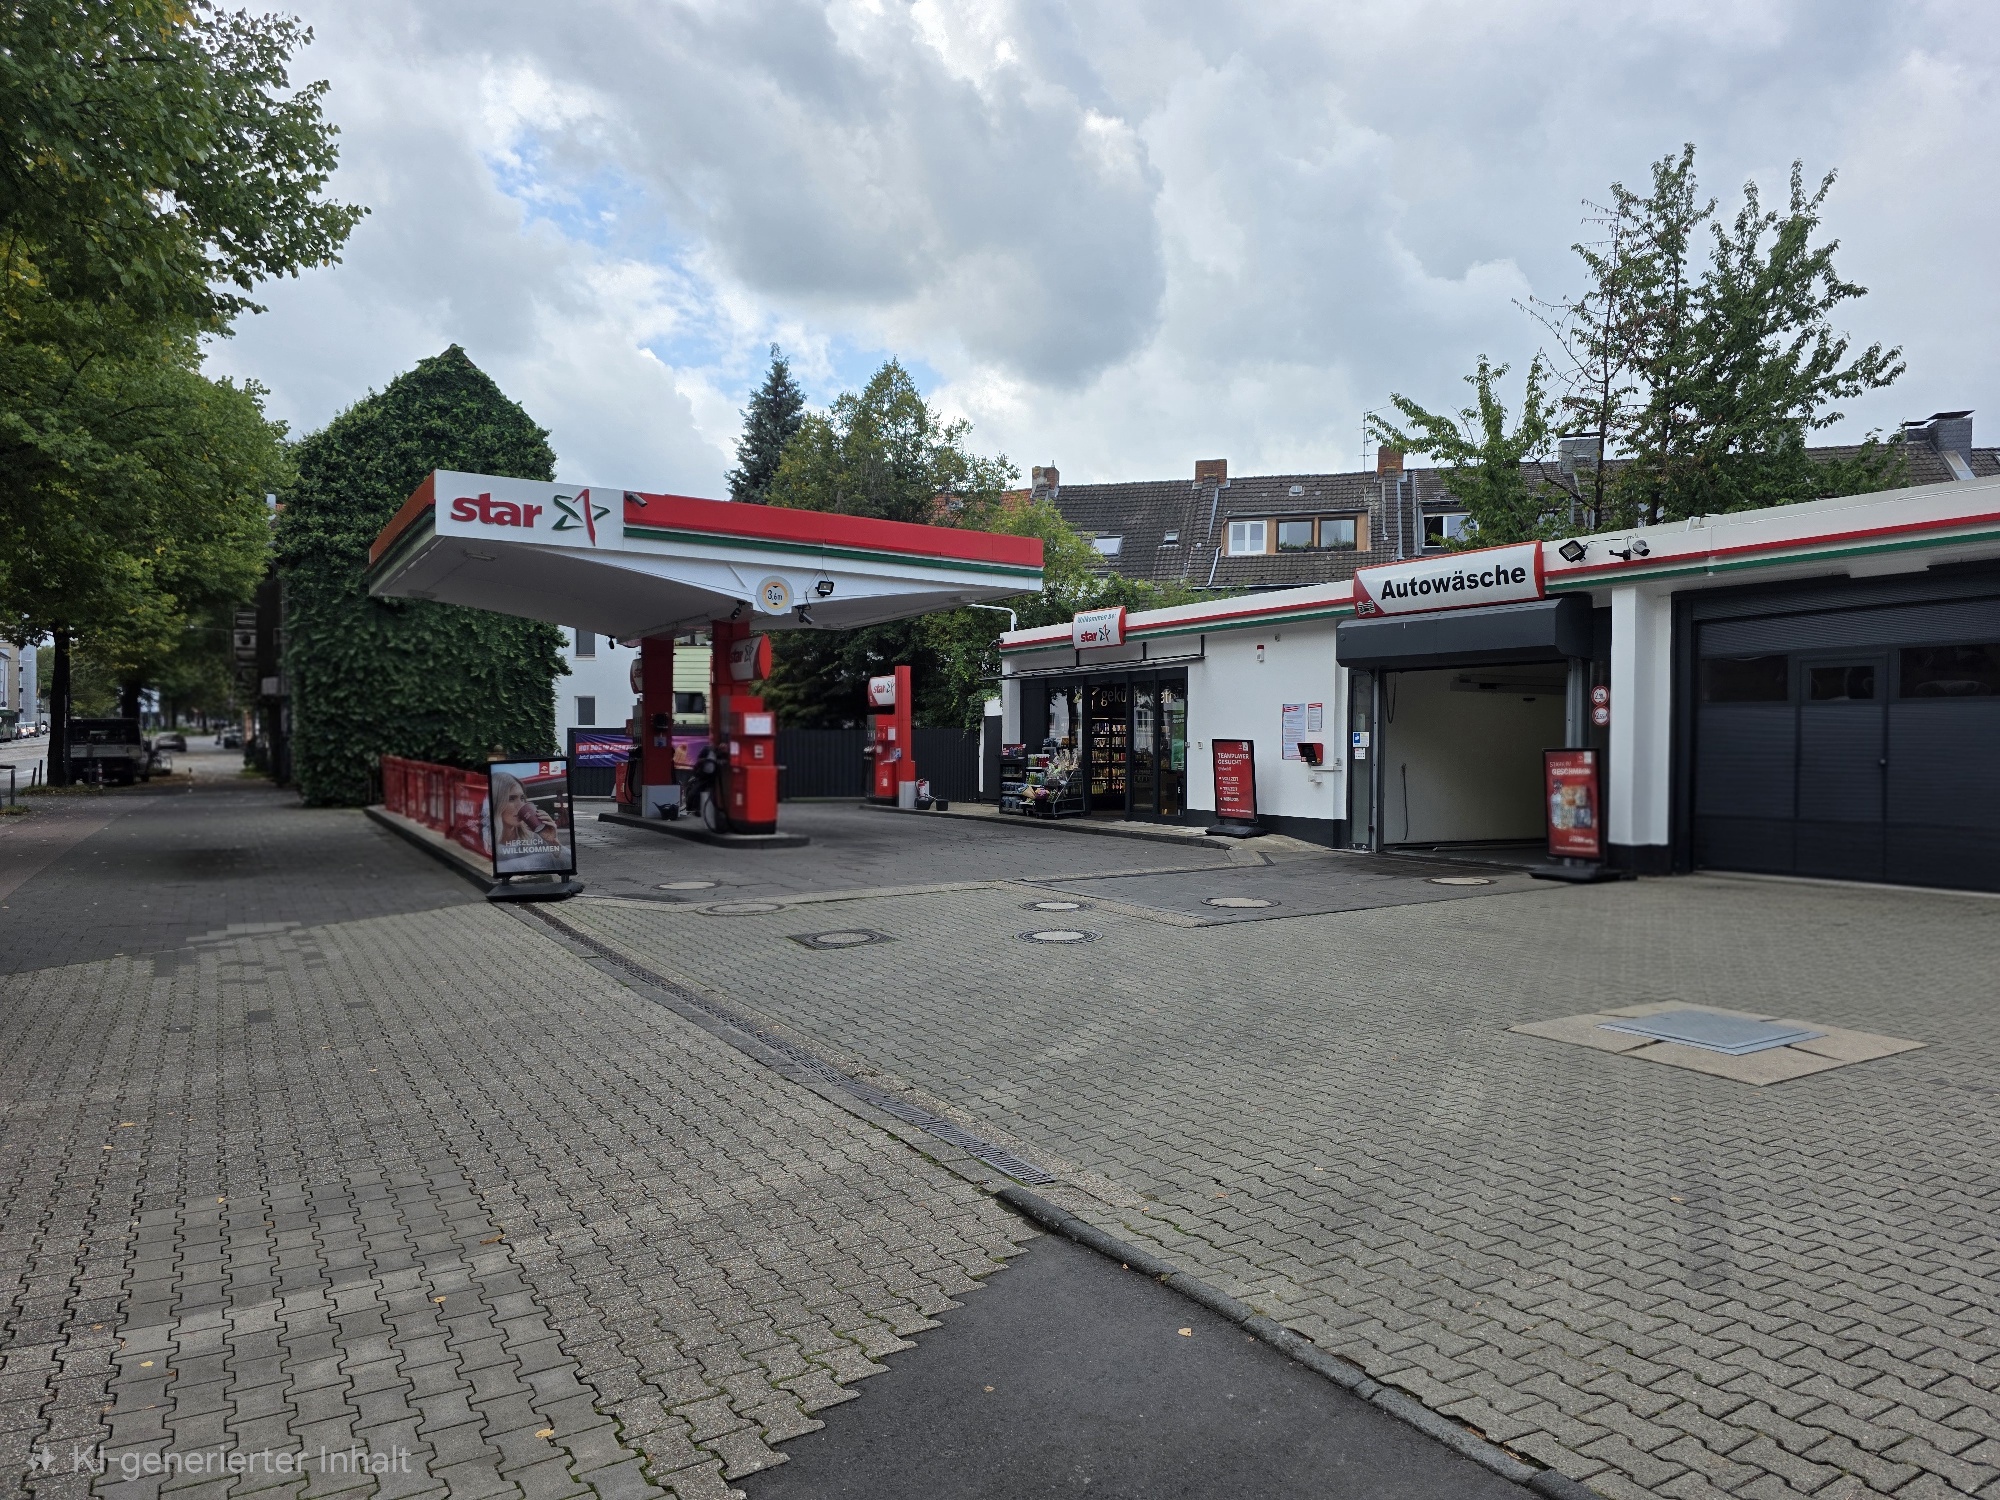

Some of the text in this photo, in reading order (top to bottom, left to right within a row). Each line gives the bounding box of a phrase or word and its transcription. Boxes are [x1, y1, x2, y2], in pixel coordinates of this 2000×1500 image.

[450, 492, 542, 528] star
[1380, 565, 1526, 601] Autowäsche
[1080, 630, 1098, 643] star
[729, 648, 743, 664] star
[873, 683, 886, 694] star
[1217, 752, 1250, 760] TEAMPLAYER
[505, 838, 544, 847] HERZLICH
[502, 845, 560, 855] WILLKOMMEN
